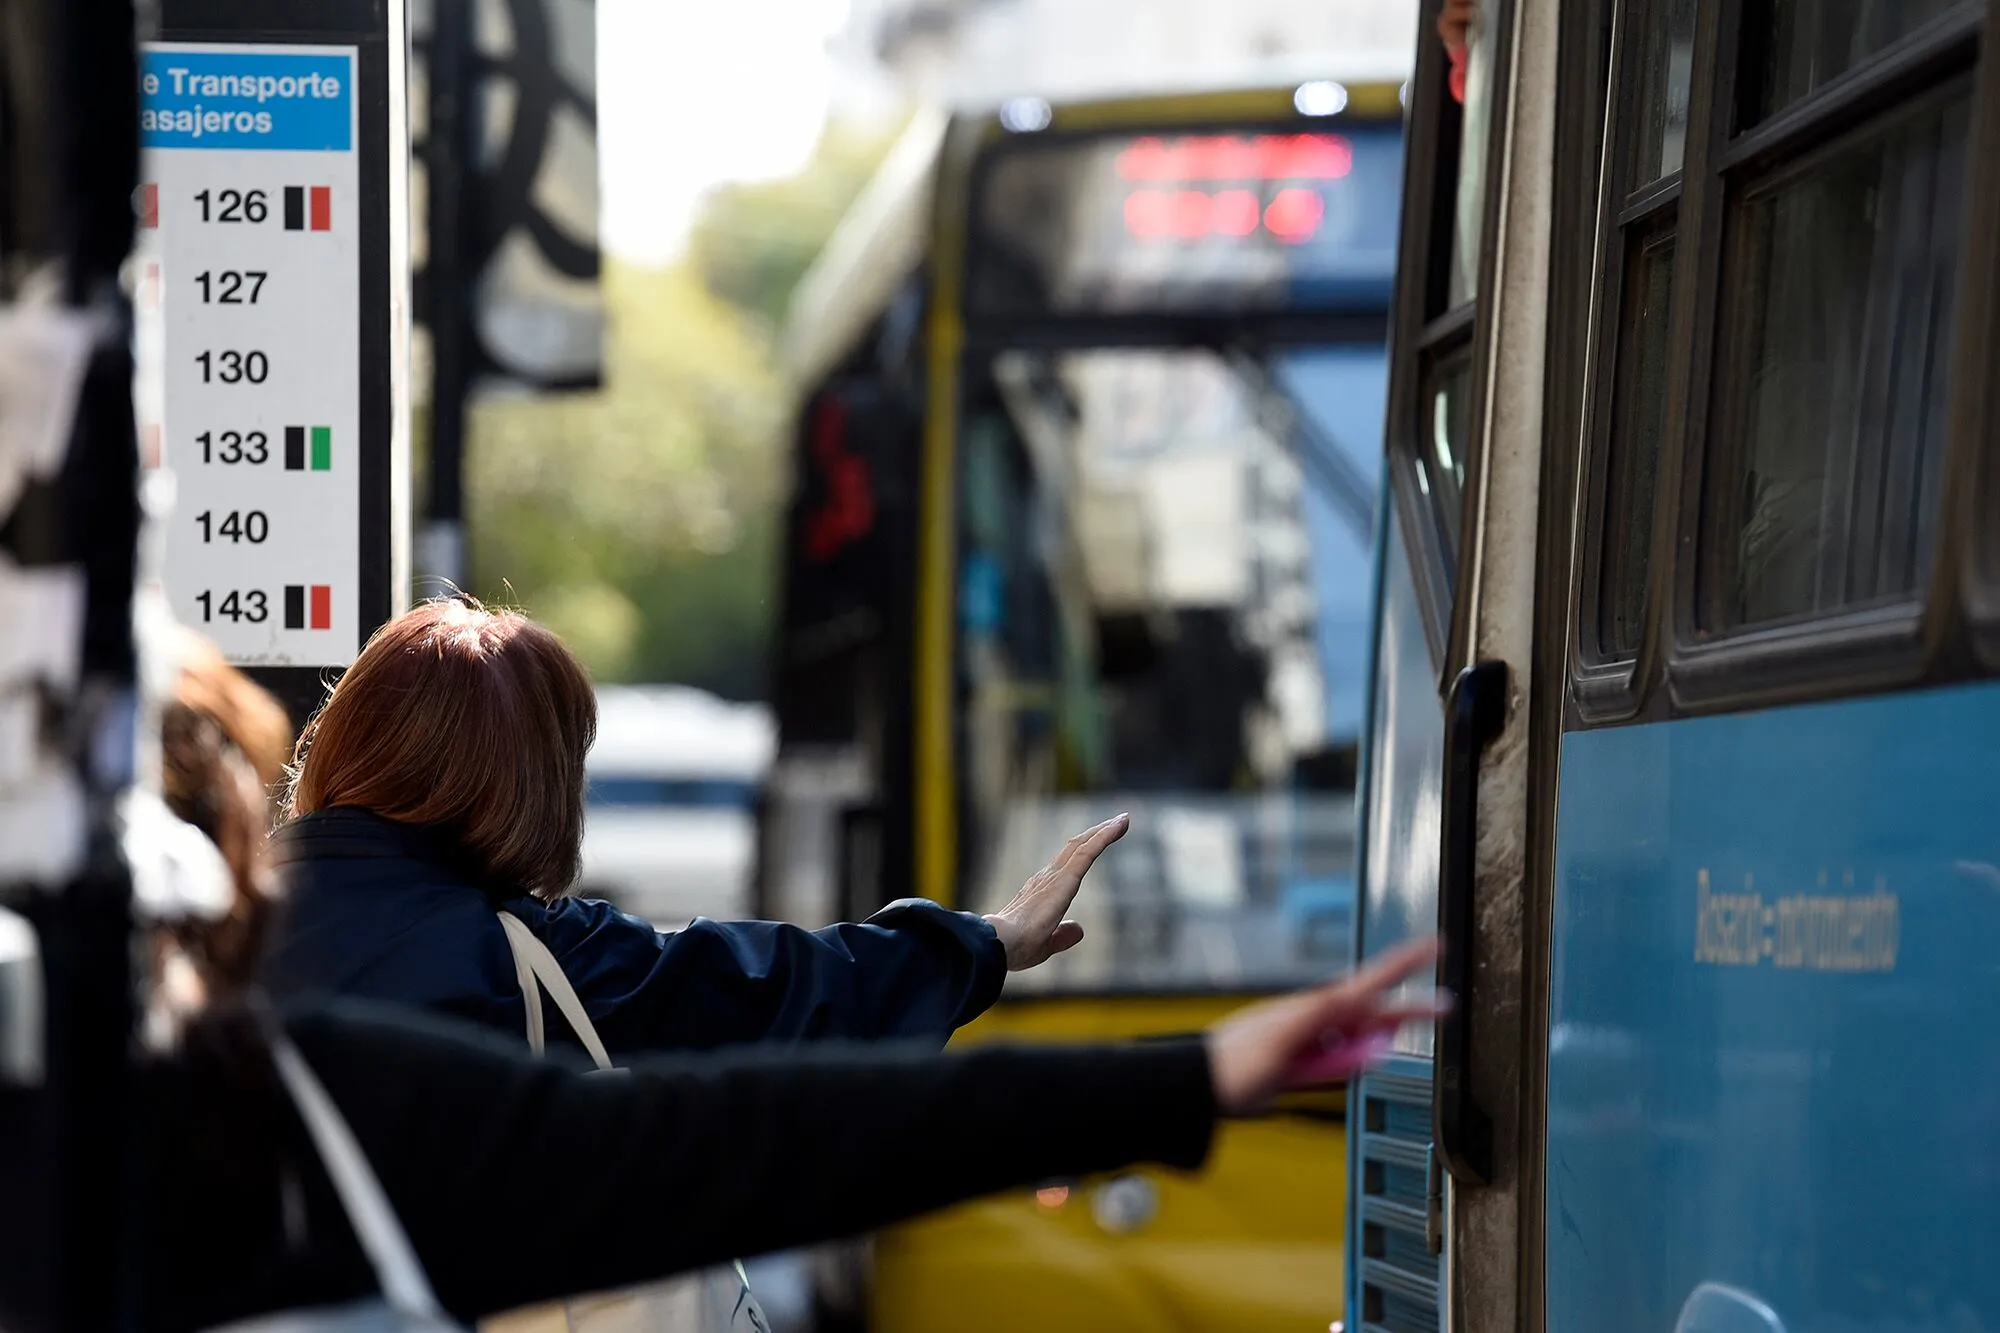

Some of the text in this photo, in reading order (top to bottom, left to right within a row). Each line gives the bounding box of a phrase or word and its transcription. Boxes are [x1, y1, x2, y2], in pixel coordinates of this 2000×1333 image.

[141, 67, 341, 103] e Transporte
[141, 104, 273, 137] asajeros
[194, 188, 268, 223] 126
[194, 270, 268, 304] 127
[194, 350, 269, 383] 130
[194, 431, 269, 464] 133
[194, 510, 269, 544] 140
[194, 589, 269, 622] 143
